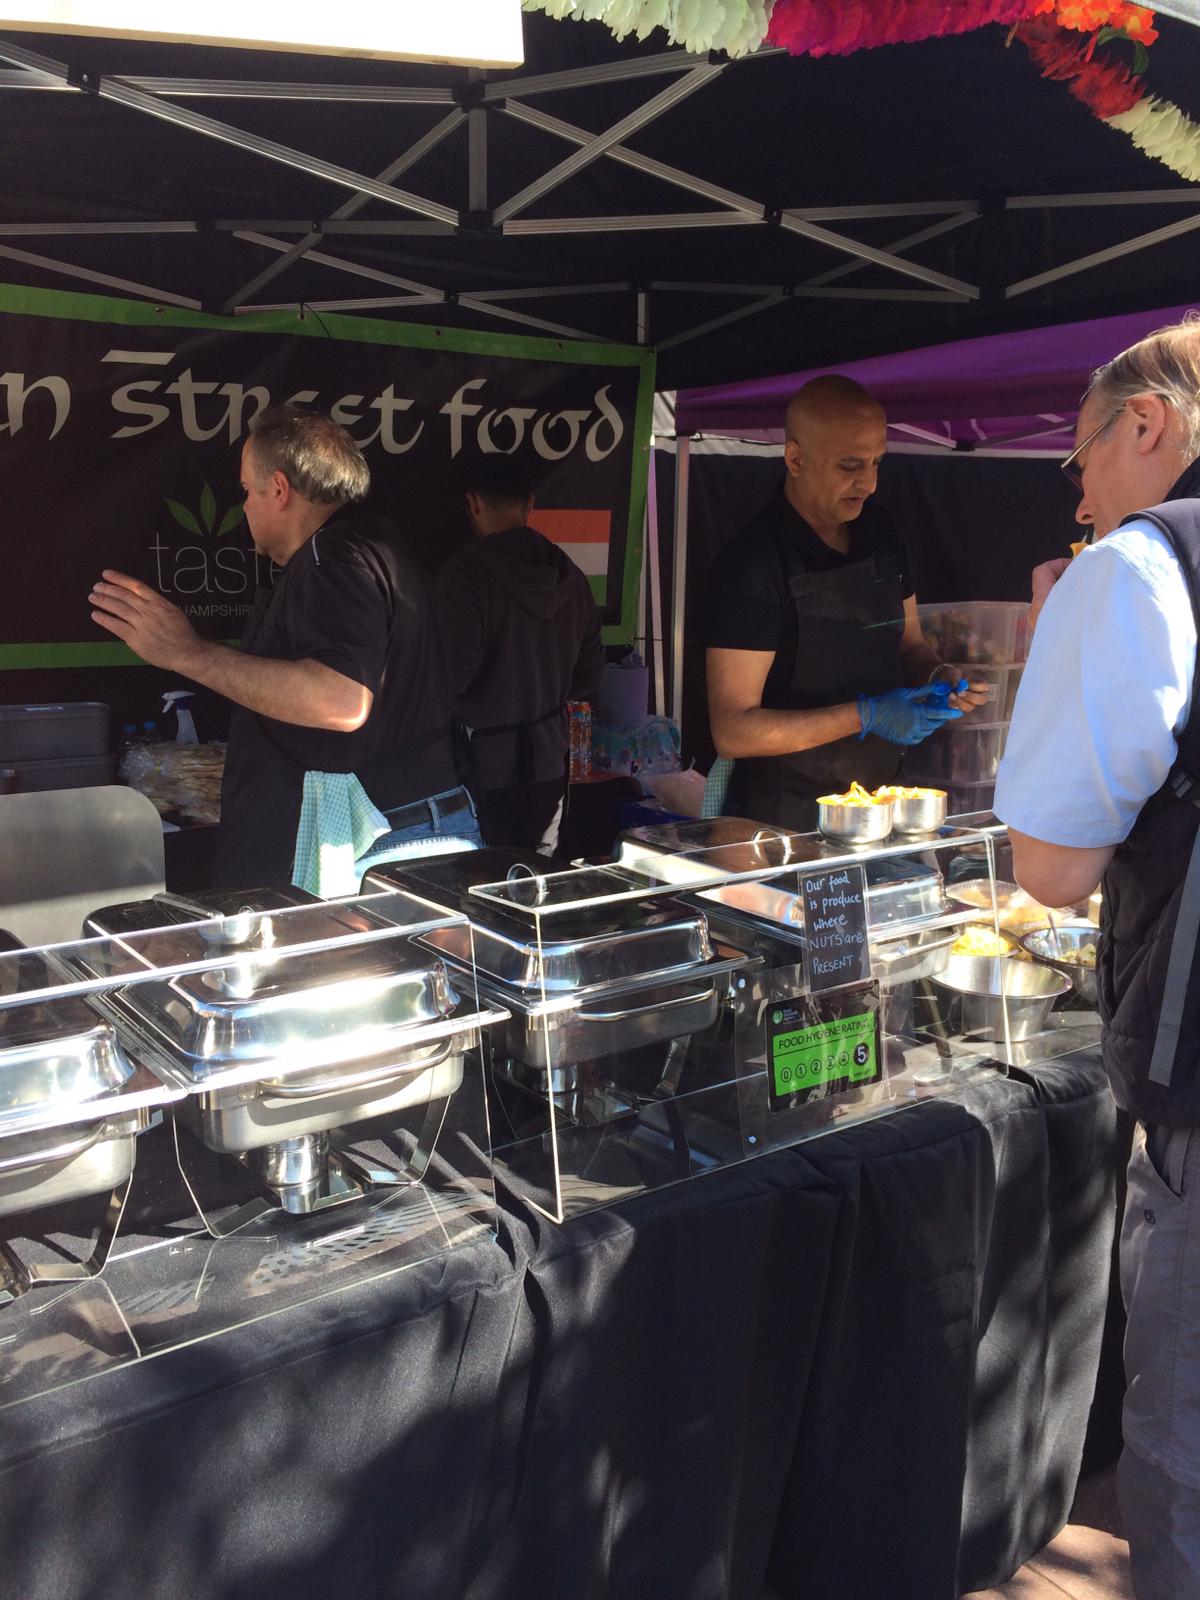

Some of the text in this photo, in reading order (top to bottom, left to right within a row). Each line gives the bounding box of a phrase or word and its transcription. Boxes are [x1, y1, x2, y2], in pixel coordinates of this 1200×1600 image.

[439, 379, 624, 462] food
[806, 870, 850, 893] Our food
[808, 891, 862, 915] is produce
[809, 931, 864, 951] NUTS are
[813, 955, 854, 975] PRESENT
[779, 1036, 804, 1049] FOOD
[857, 1046, 867, 1063] 5
